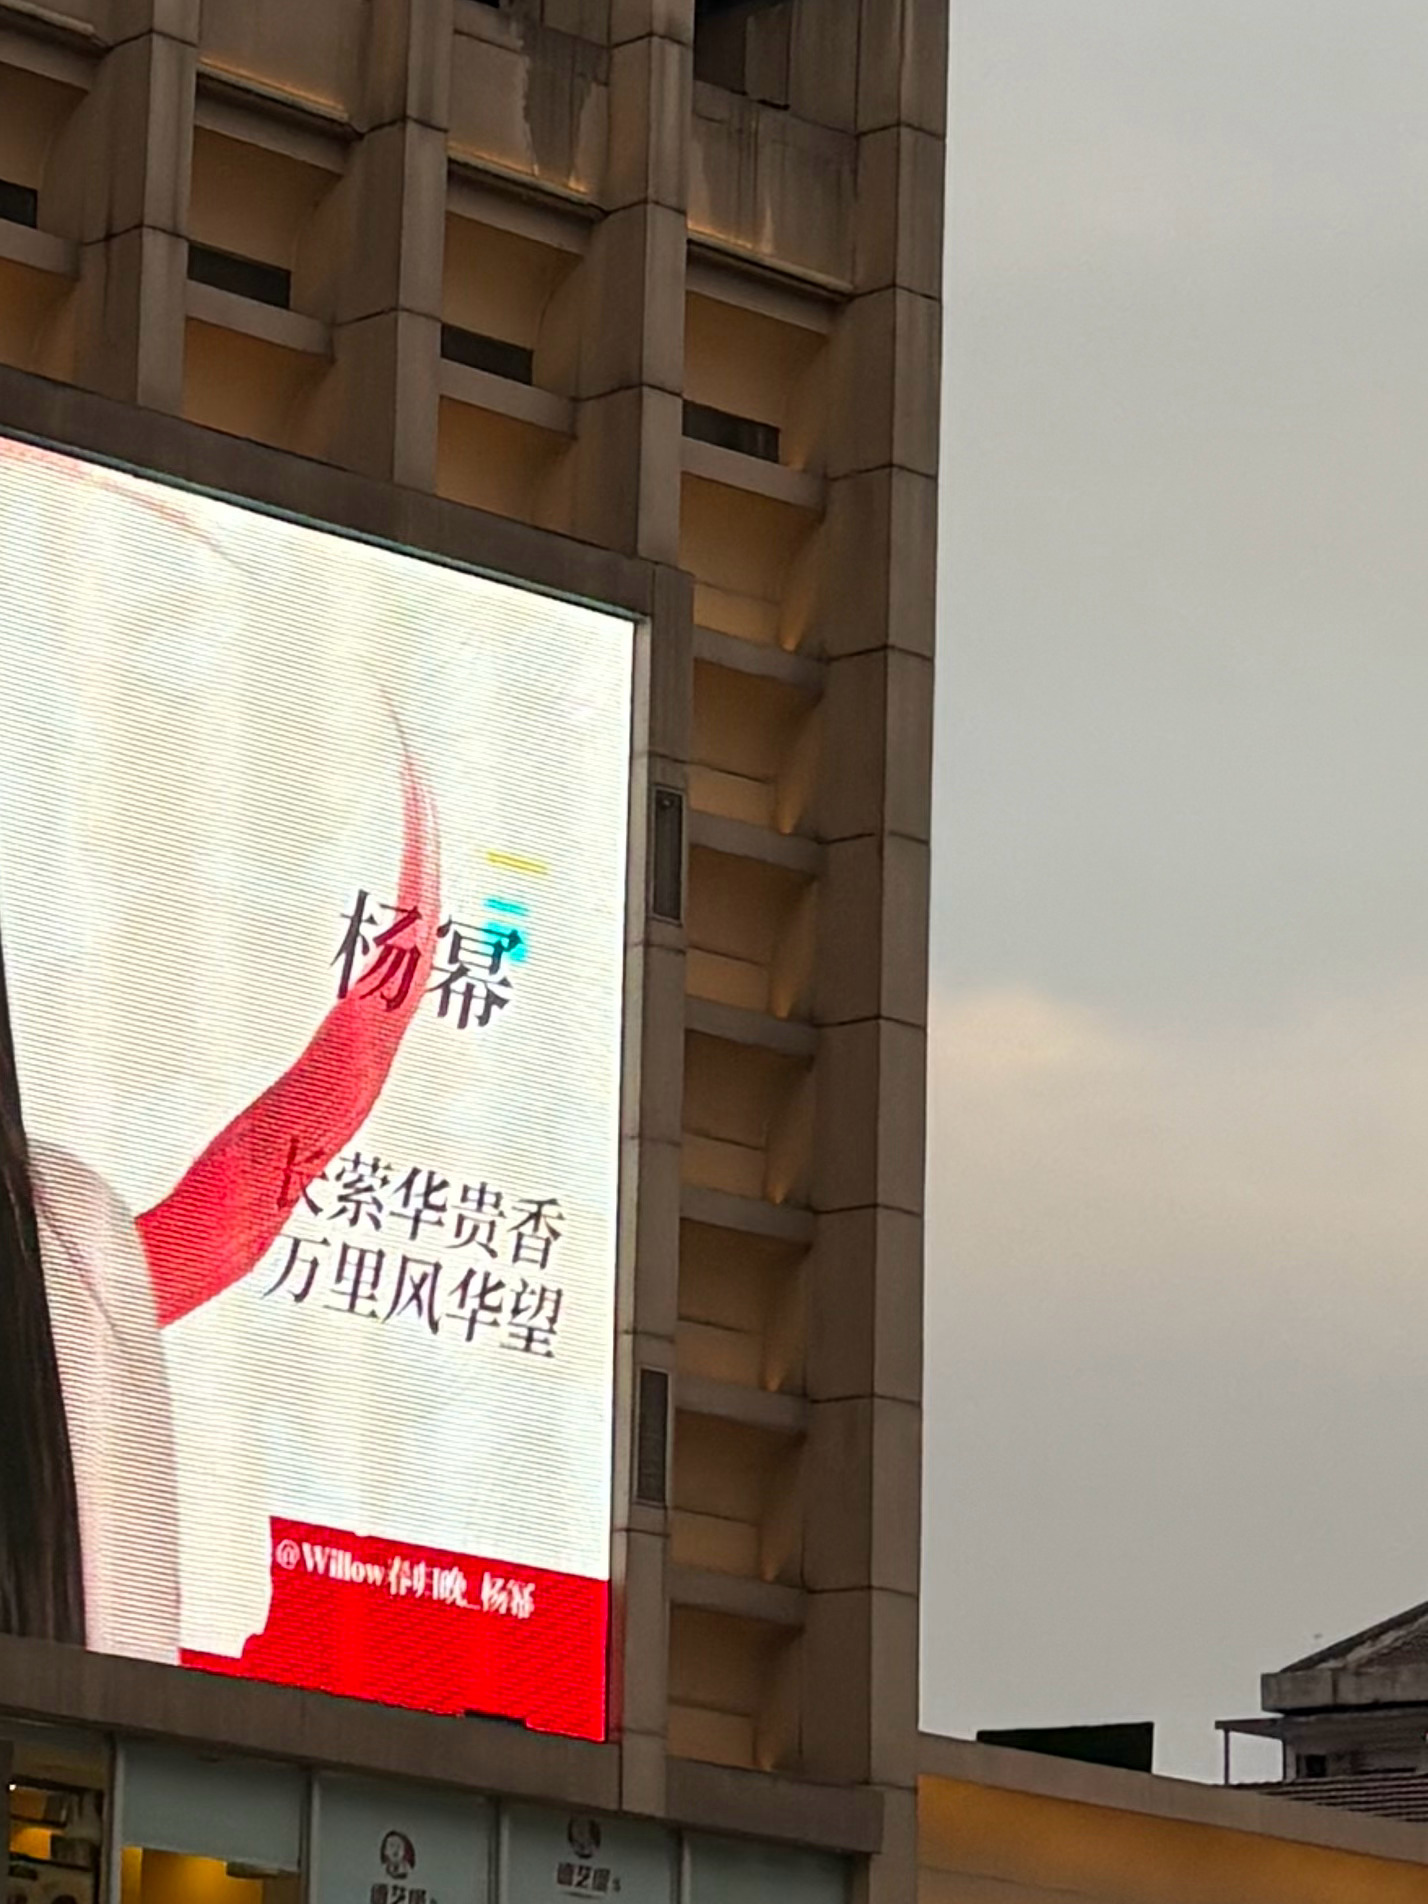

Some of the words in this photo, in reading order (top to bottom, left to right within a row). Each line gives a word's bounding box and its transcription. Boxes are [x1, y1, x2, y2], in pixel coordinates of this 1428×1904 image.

[330, 889, 523, 1031] 杨幂
[262, 1232, 564, 1360] 万里风华望
